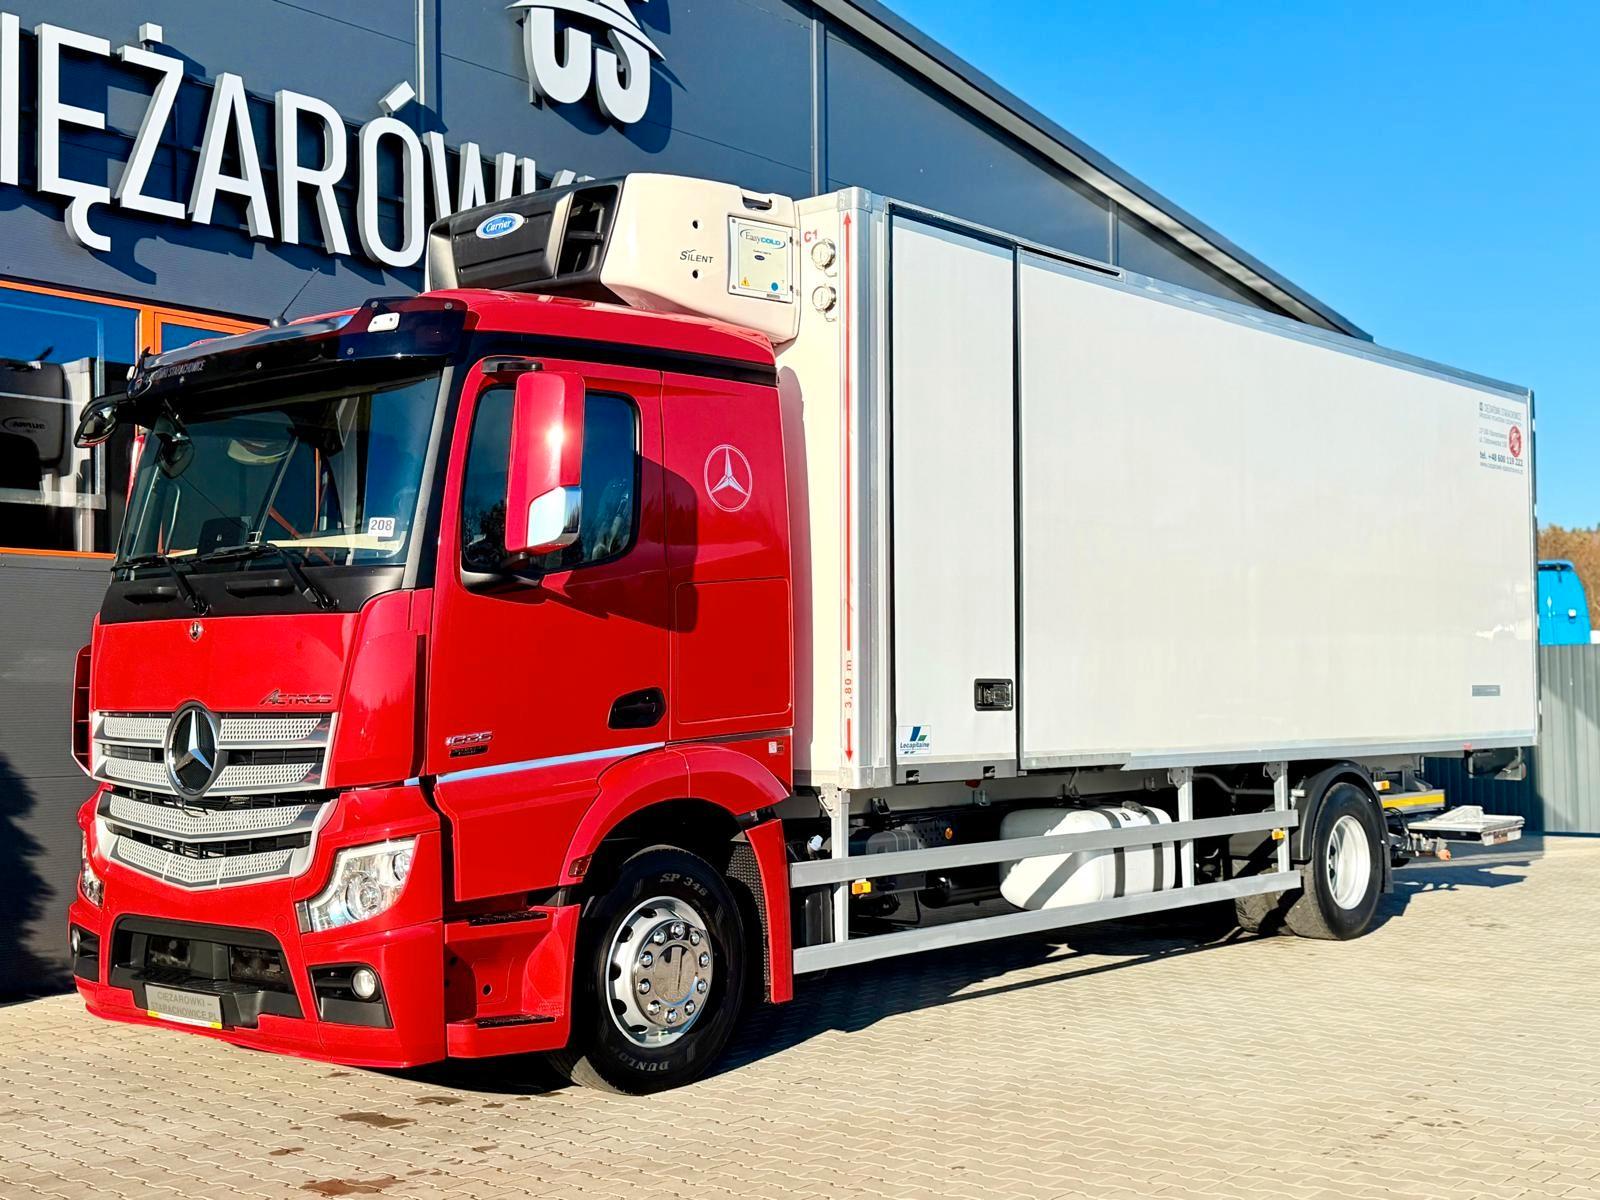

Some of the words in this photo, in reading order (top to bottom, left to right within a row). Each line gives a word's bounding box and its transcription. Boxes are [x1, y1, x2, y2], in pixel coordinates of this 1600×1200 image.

[486, 219, 513, 233] Carrier
[803, 229, 817, 243] C1
[370, 519, 393, 531] 208
[846, 659, 852, 672] m
[900, 742, 929, 750] Lecapitaine
[660, 872, 681, 884] SP
